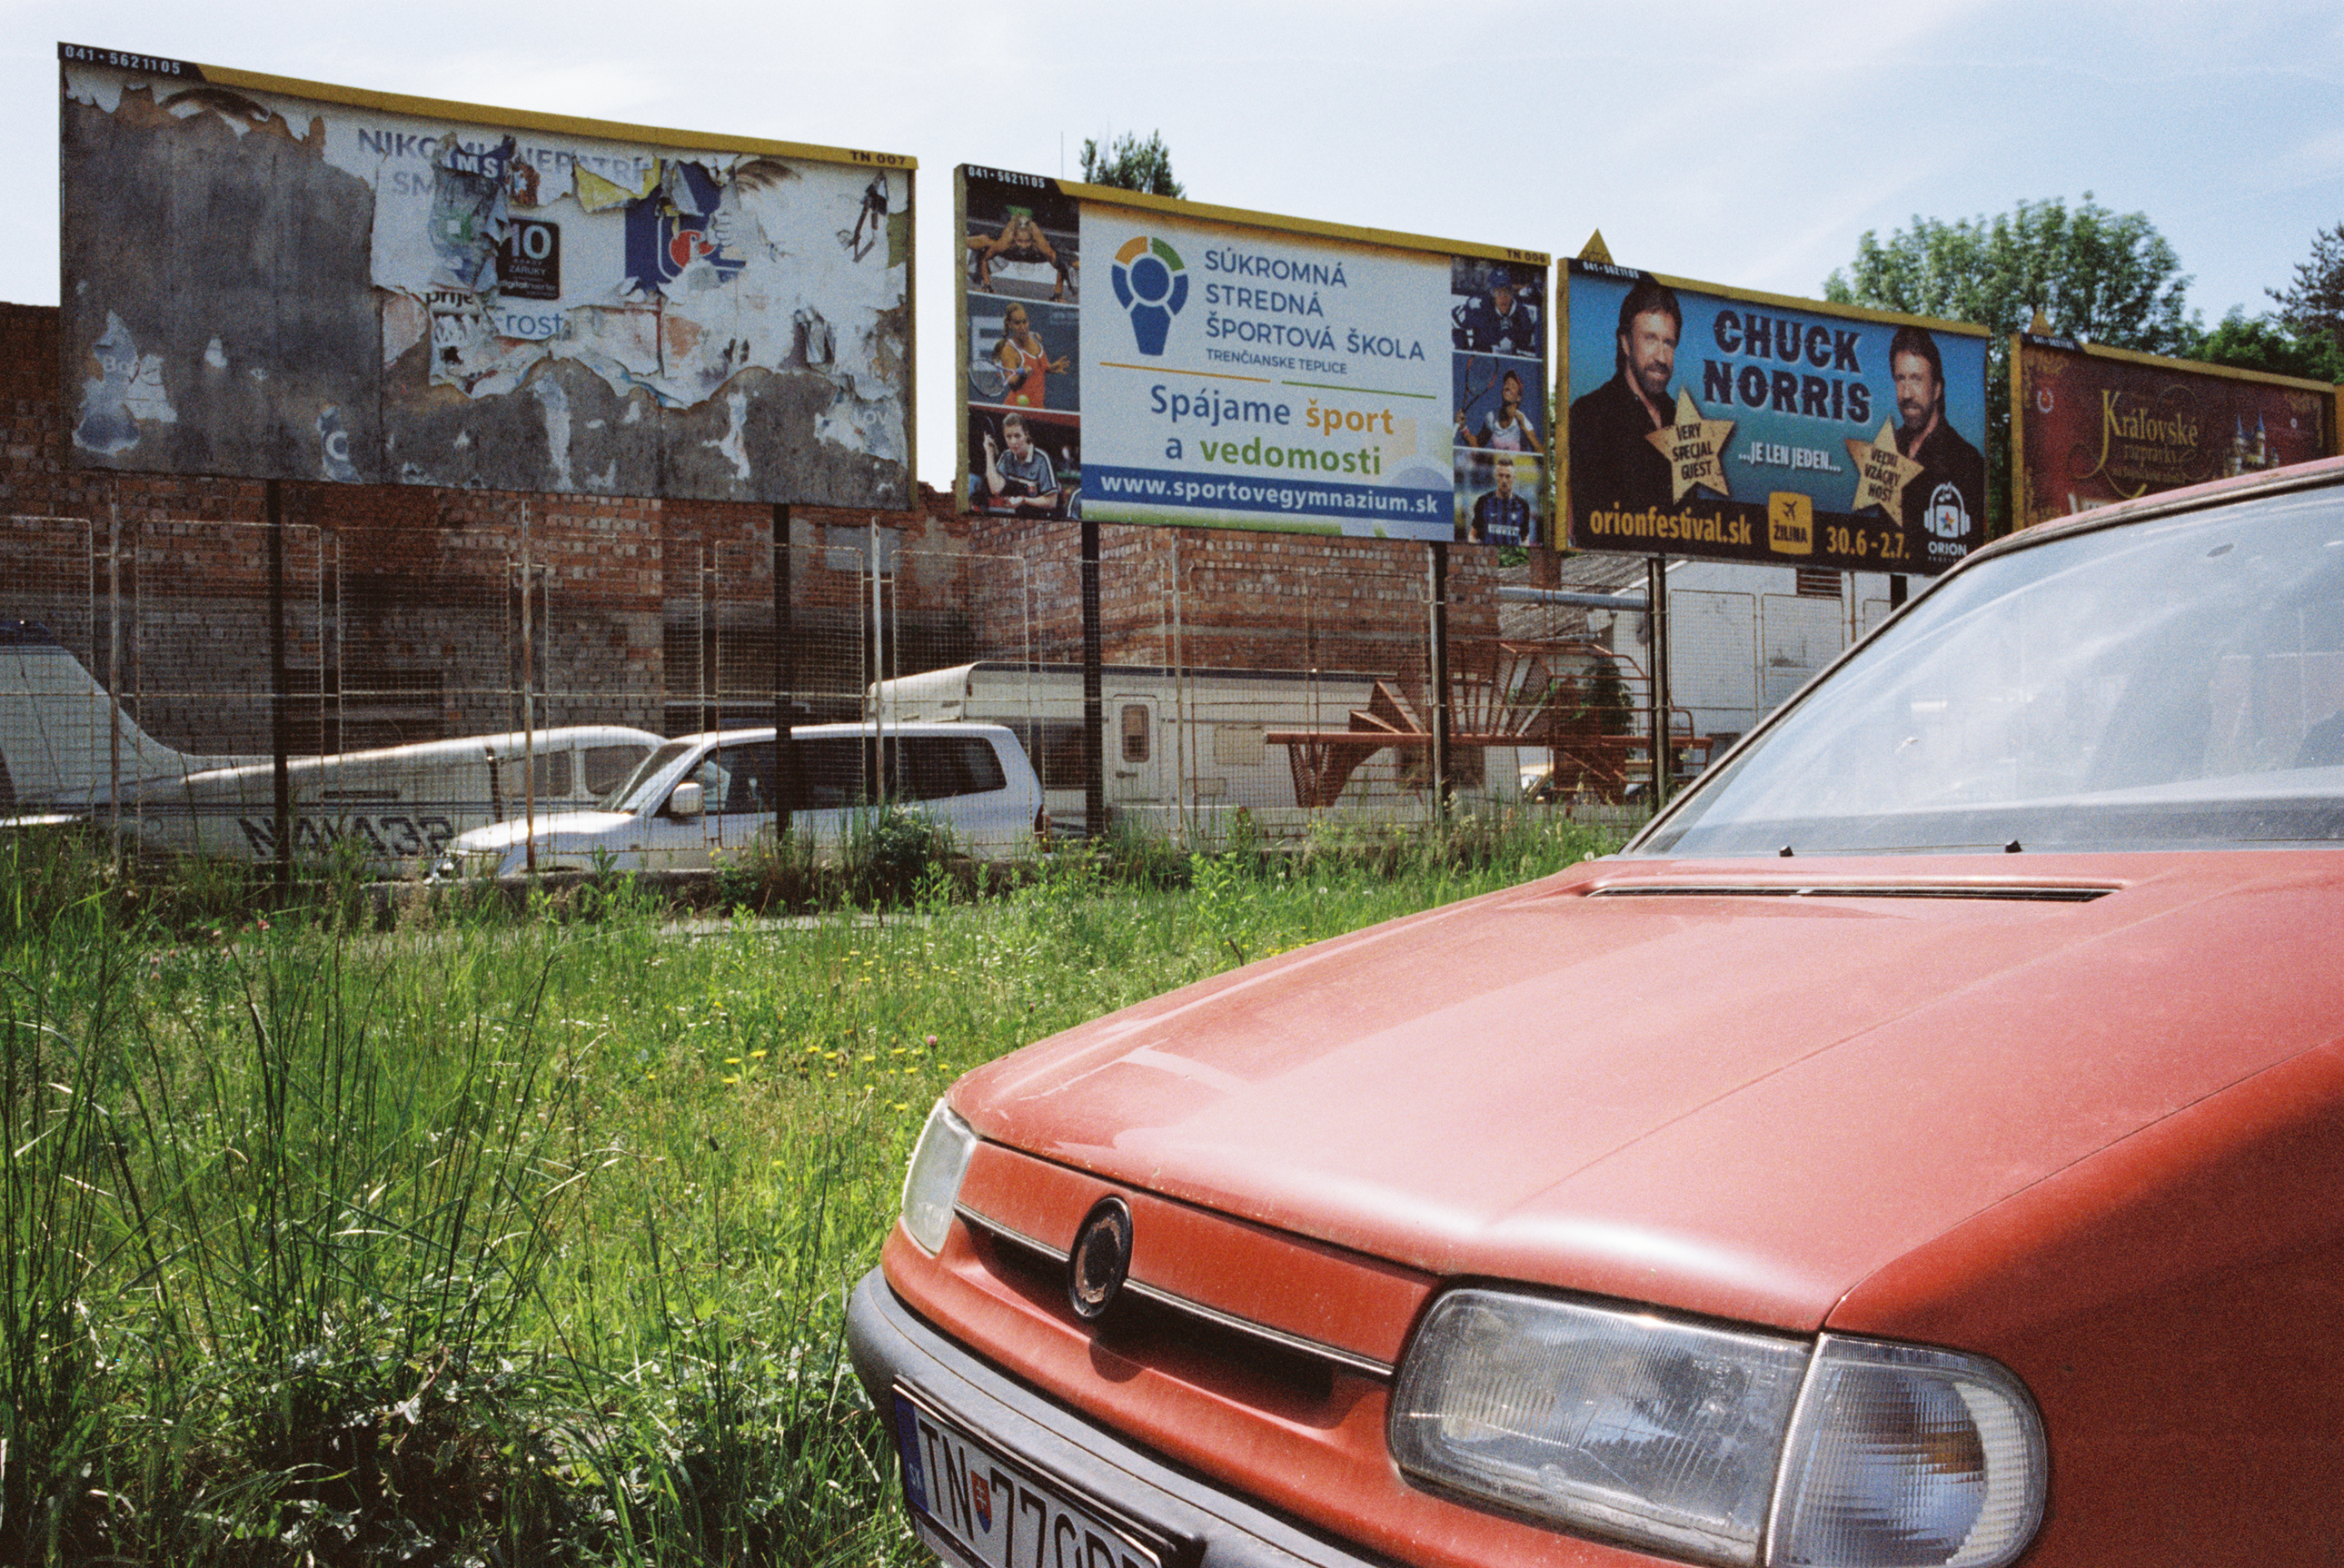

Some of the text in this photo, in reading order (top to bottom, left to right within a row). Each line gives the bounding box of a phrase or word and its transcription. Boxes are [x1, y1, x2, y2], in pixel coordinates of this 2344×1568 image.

[849, 149, 906, 164] TN 007
[510, 223, 551, 260] 10
[1205, 247, 1347, 288] SÚKROMNÁ
[1206, 283, 1324, 317] STREDNÁ
[1206, 311, 1425, 361] ŠPORTOVÁ ŠKOLA
[1713, 310, 1862, 373] CHUCK
[1207, 348, 1347, 374] TRENČIANSKE TEPLICE
[1150, 384, 1394, 436] Spájame šport
[1703, 359, 1872, 423] NORRIS
[1165, 436, 1381, 475] a vedomosti
[1765, 444, 1790, 465] LEN
[1100, 474, 1438, 514] www.sportovegymnazium.sk
[1590, 501, 1753, 545] orionfestival.sk
[1773, 520, 1808, 543] ŽILINA
[1928, 541, 1968, 557] ORION
[919, 1417, 975, 1543] TN
